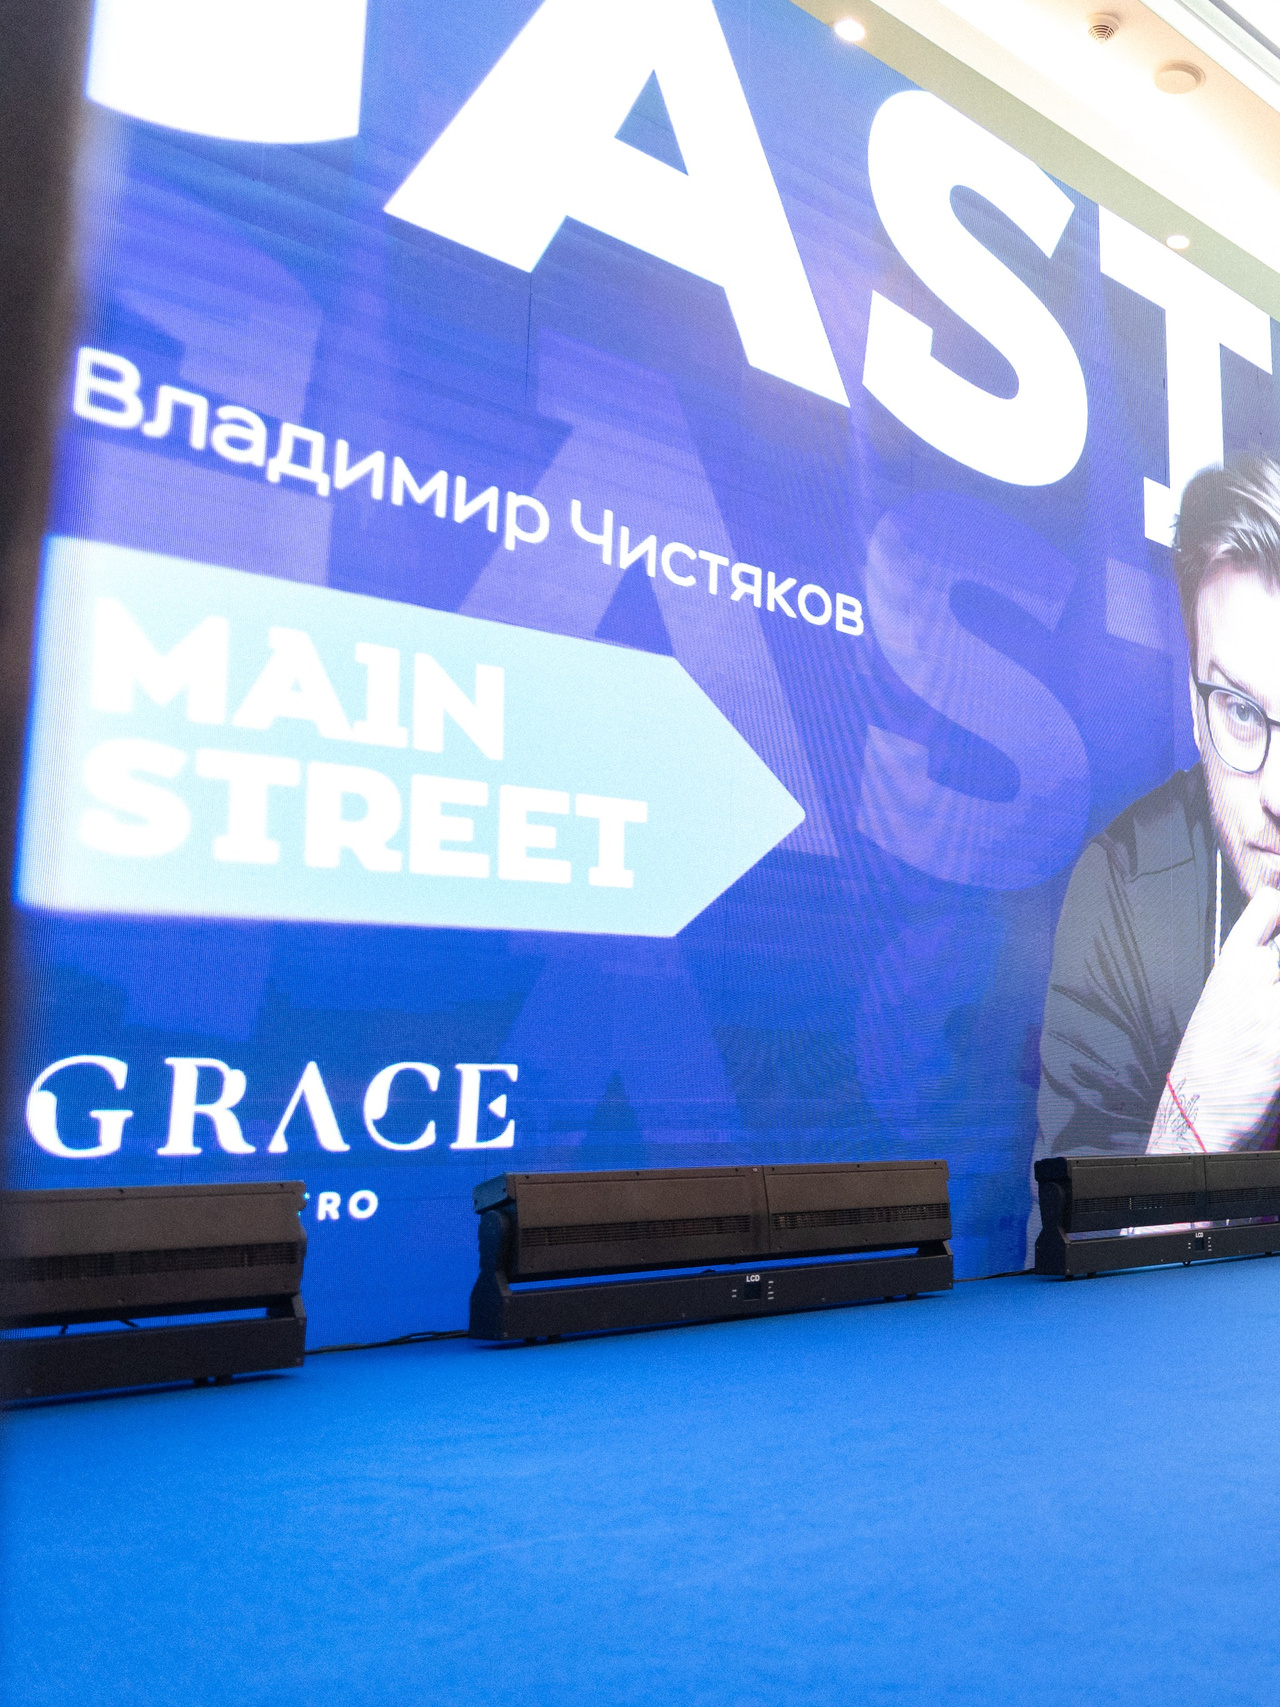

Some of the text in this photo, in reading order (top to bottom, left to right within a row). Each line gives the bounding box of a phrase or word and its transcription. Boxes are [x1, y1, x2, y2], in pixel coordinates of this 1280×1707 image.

[72, 346, 865, 638] Владимир Чистяков
[89, 598, 505, 760] MAIN
[77, 737, 648, 889] STREET
[26, 1053, 519, 1158] GRACE
[746, 1274, 760, 1283] LCD
